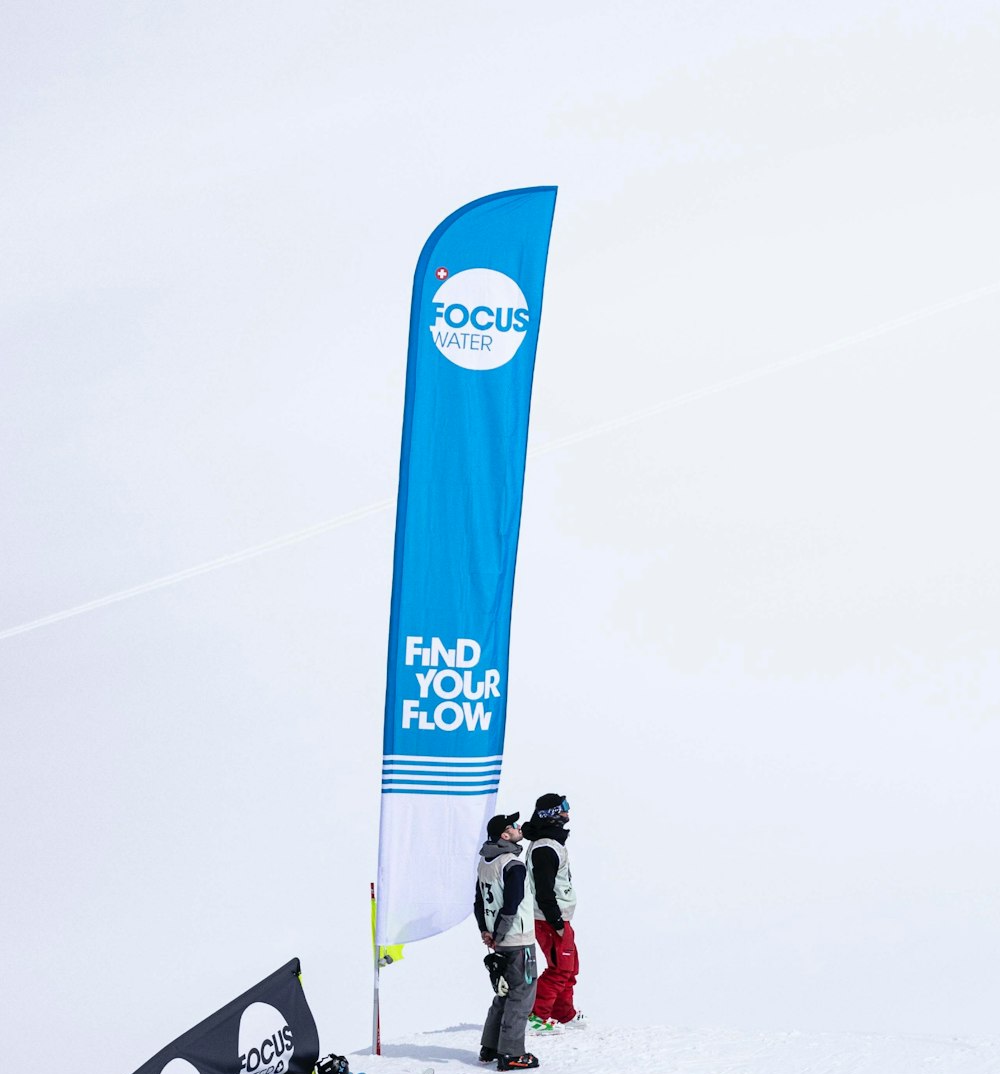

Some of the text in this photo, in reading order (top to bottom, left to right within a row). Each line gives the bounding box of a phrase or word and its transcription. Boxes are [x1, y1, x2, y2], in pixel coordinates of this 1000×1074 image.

[430, 302, 530, 332] FOCUS
[434, 331, 493, 351] WATER
[405, 636, 481, 668] FIND
[416, 669, 500, 700] YOUR
[402, 699, 492, 731] FLOW
[239, 1025, 294, 1074] FOCUS
